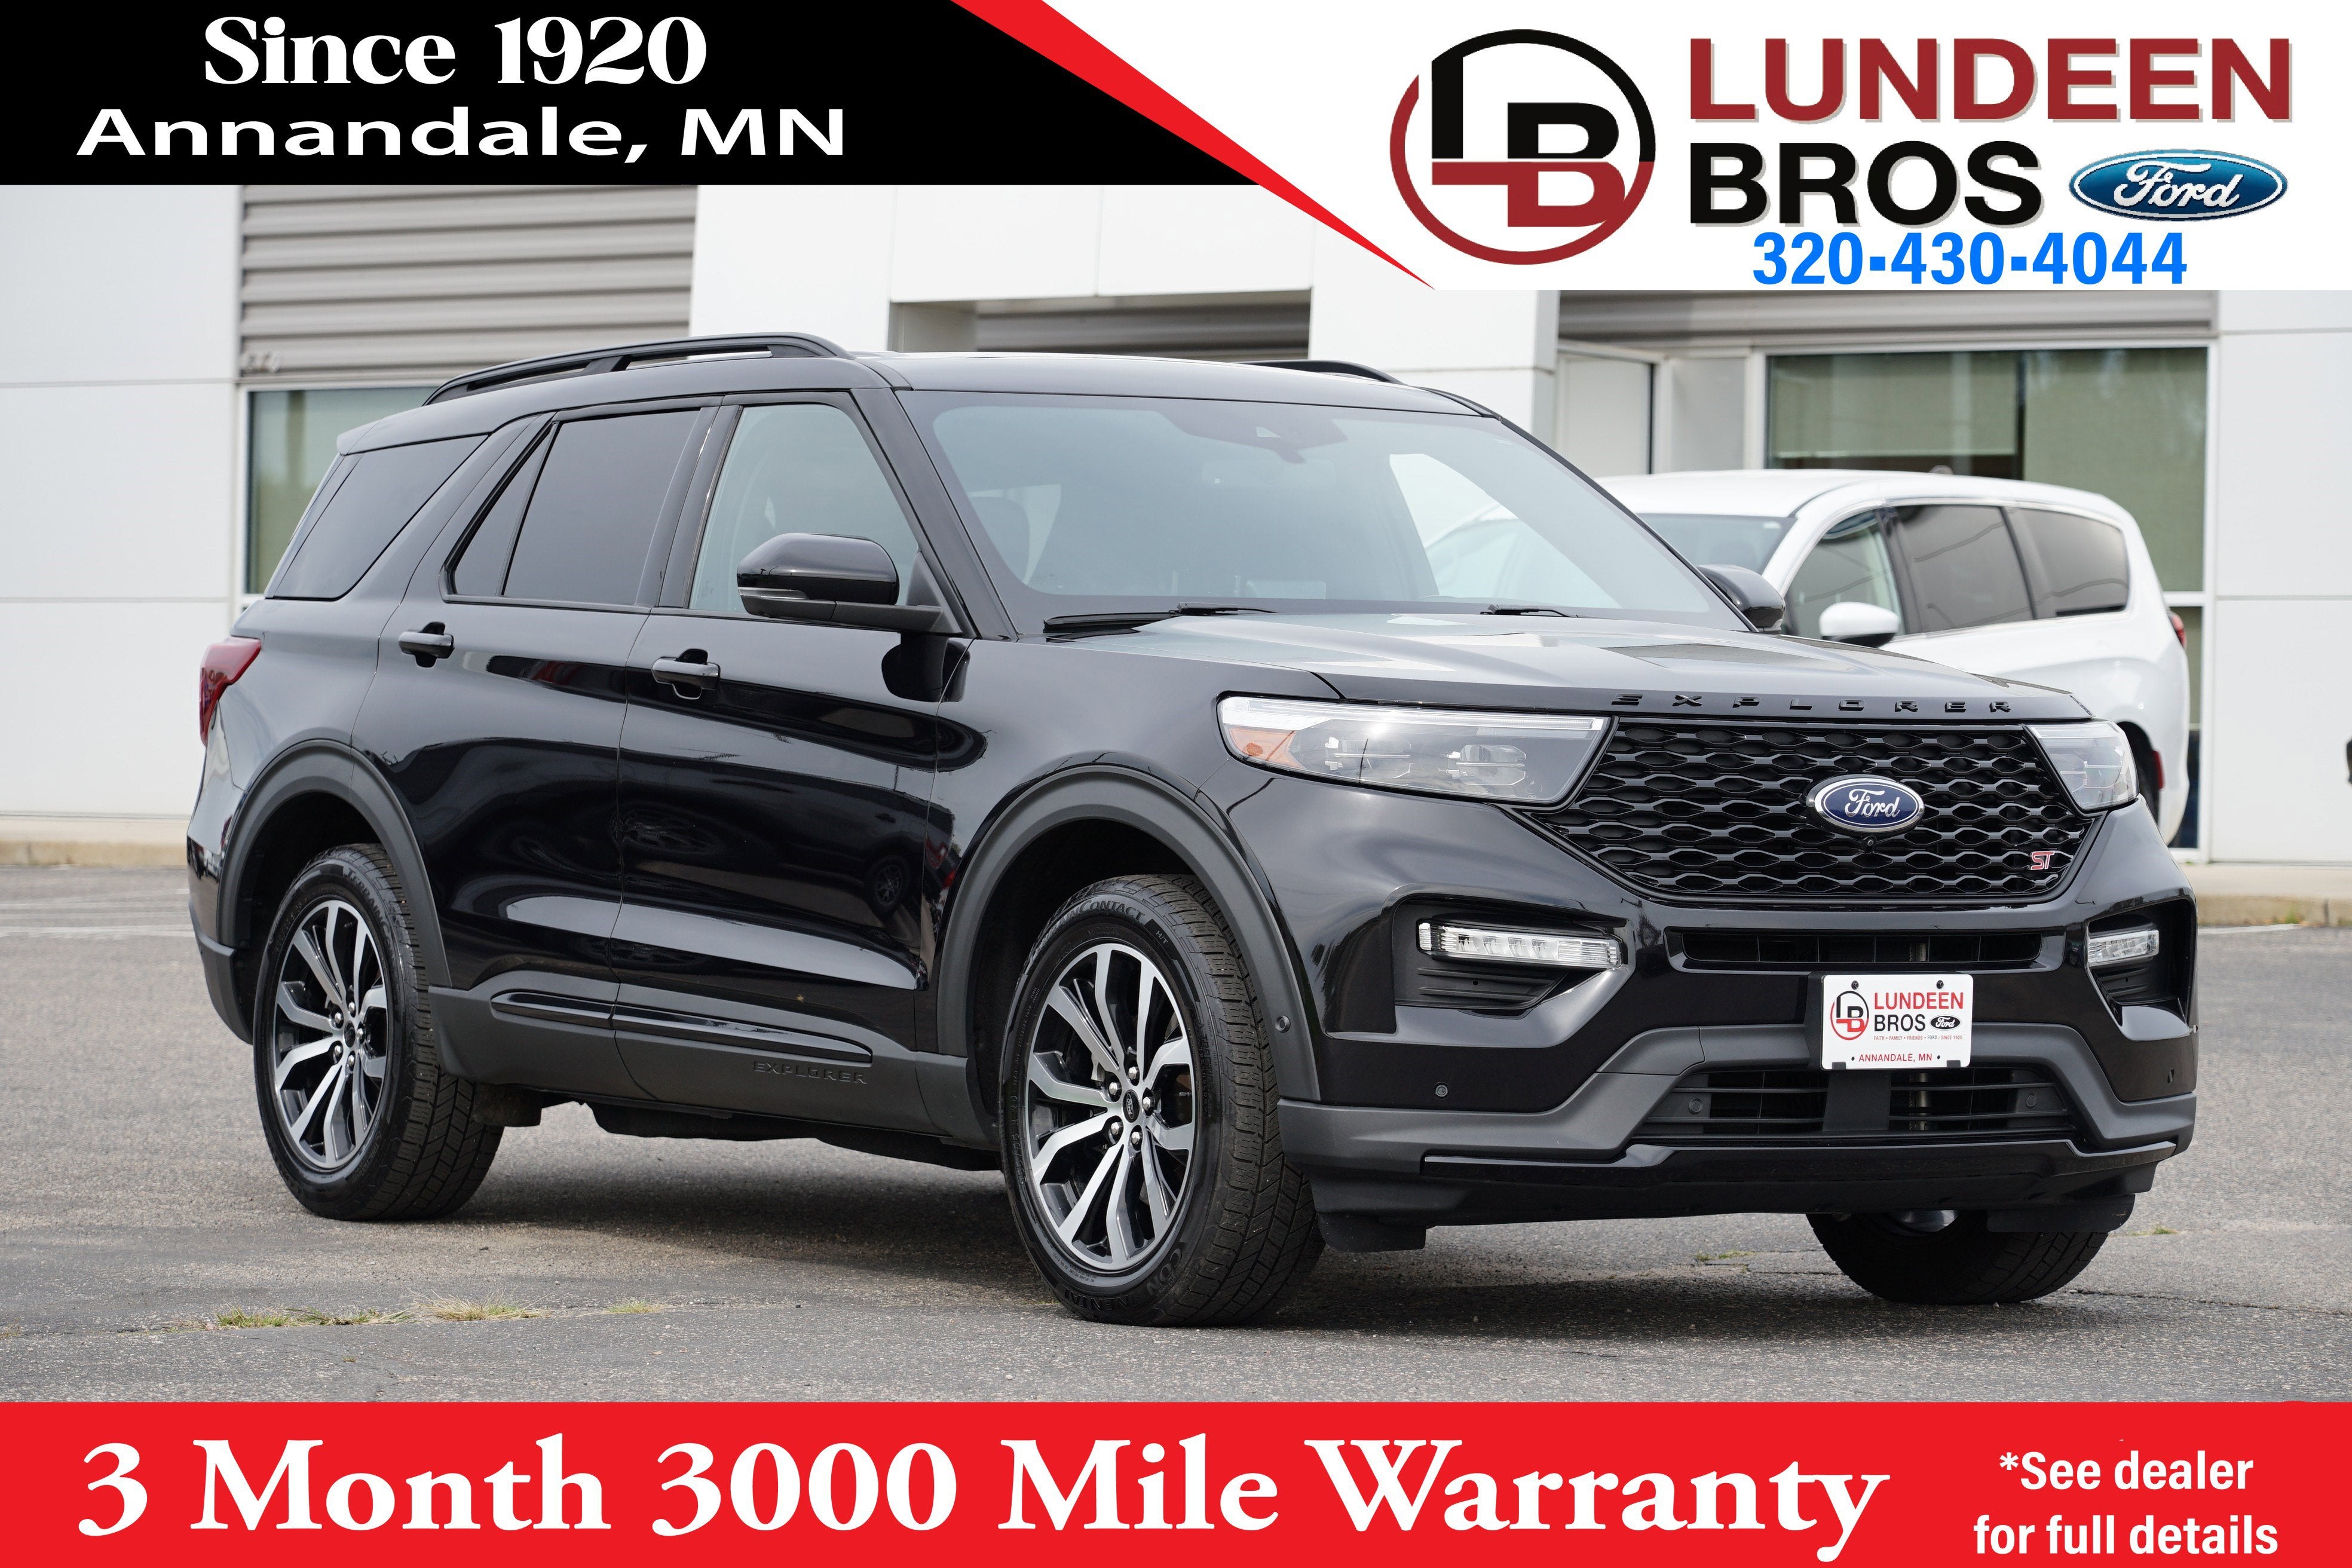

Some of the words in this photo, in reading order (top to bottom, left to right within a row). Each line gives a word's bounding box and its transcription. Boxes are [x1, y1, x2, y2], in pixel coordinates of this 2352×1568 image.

[1612, 693, 2011, 713] EXPLORER
[1844, 788, 1901, 818] Ford
[2031, 850, 2055, 870] ST
[1155, 930, 1169, 945] H/T
[1874, 992, 1964, 1010] LUNDEEN
[1873, 1013, 1926, 1032] BROS
[1858, 1053, 1916, 1063] ANNANDALE,
[1918, 1053, 1933, 1061] MN
[753, 1061, 867, 1085] EXPLORER
